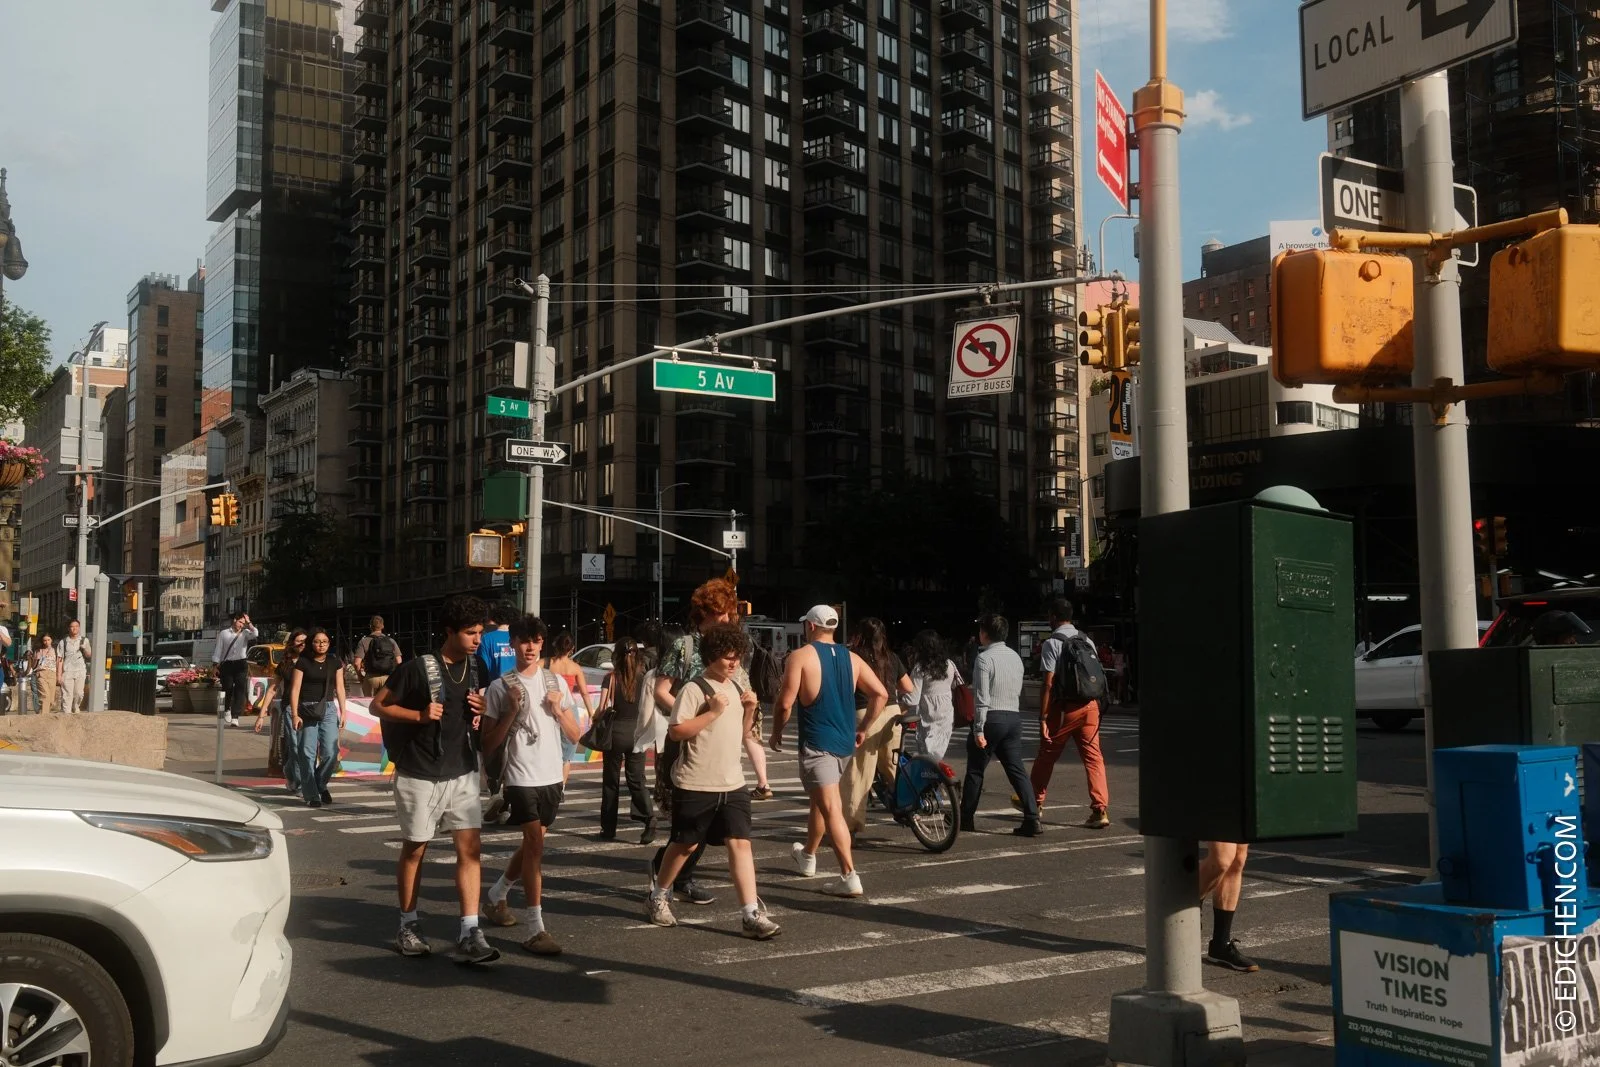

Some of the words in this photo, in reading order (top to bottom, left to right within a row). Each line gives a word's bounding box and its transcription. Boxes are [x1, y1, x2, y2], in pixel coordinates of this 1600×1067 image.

[1314, 15, 1394, 70] LOCAL
[1339, 184, 1383, 222] ONE
[1278, 242, 1284, 250] A
[1285, 241, 1316, 250] browser
[1318, 241, 1330, 250] tha
[698, 370, 707, 387] 5
[714, 372, 735, 390] Av
[951, 384, 981, 394] EXCEPT
[984, 380, 1011, 391] BUSES
[500, 400, 506, 414] 5
[509, 401, 519, 411] Av
[516, 446, 535, 456] ONE
[542, 448, 561, 458] WAY
[1190, 448, 1263, 470] LATIRON
[1374, 950, 1449, 981] VISION
[1380, 976, 1448, 1008] TIMES
[1365, 1000, 1388, 1013] Truth
[1391, 1006, 1436, 1023] Inspiration
[1439, 1016, 1464, 1029] Hope
